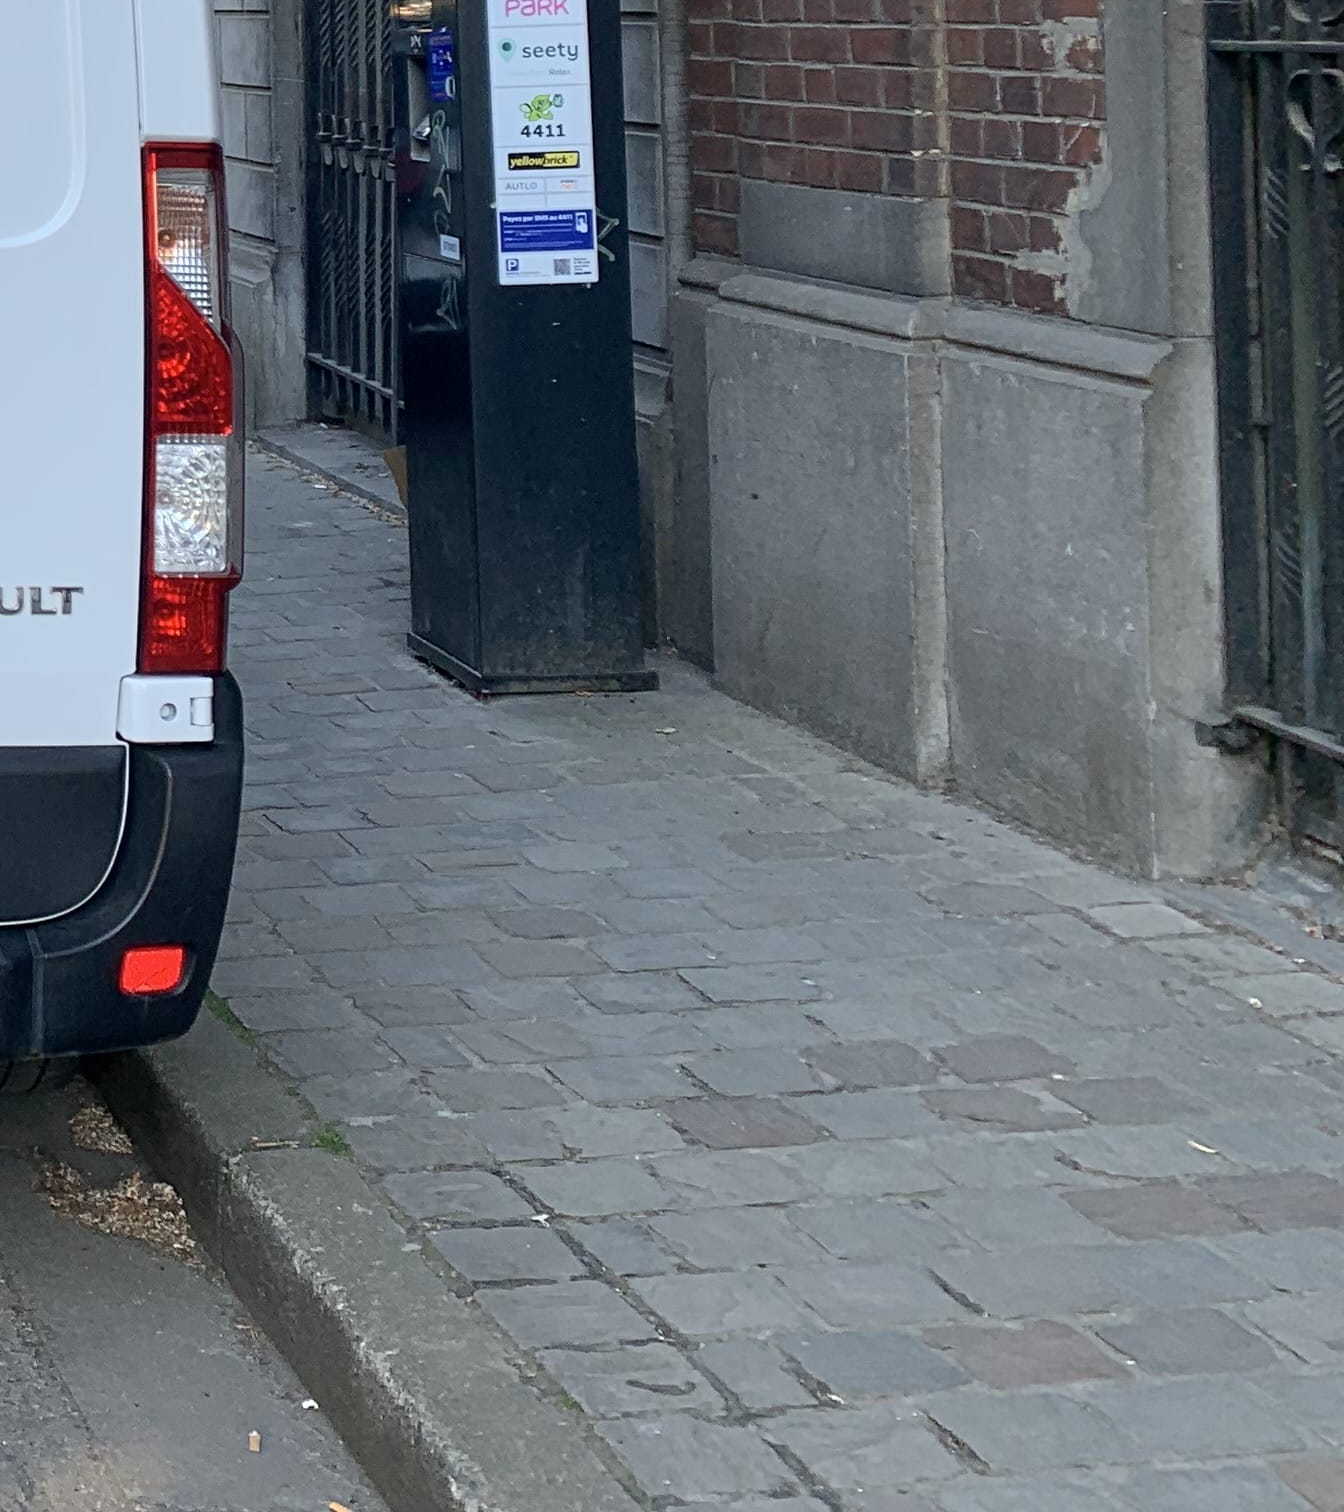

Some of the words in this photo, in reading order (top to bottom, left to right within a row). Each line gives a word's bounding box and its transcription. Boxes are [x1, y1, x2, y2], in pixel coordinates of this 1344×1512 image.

[522, 42, 578, 61] seety
[520, 124, 566, 138] 4411
[510, 155, 569, 169] yellowbrick
